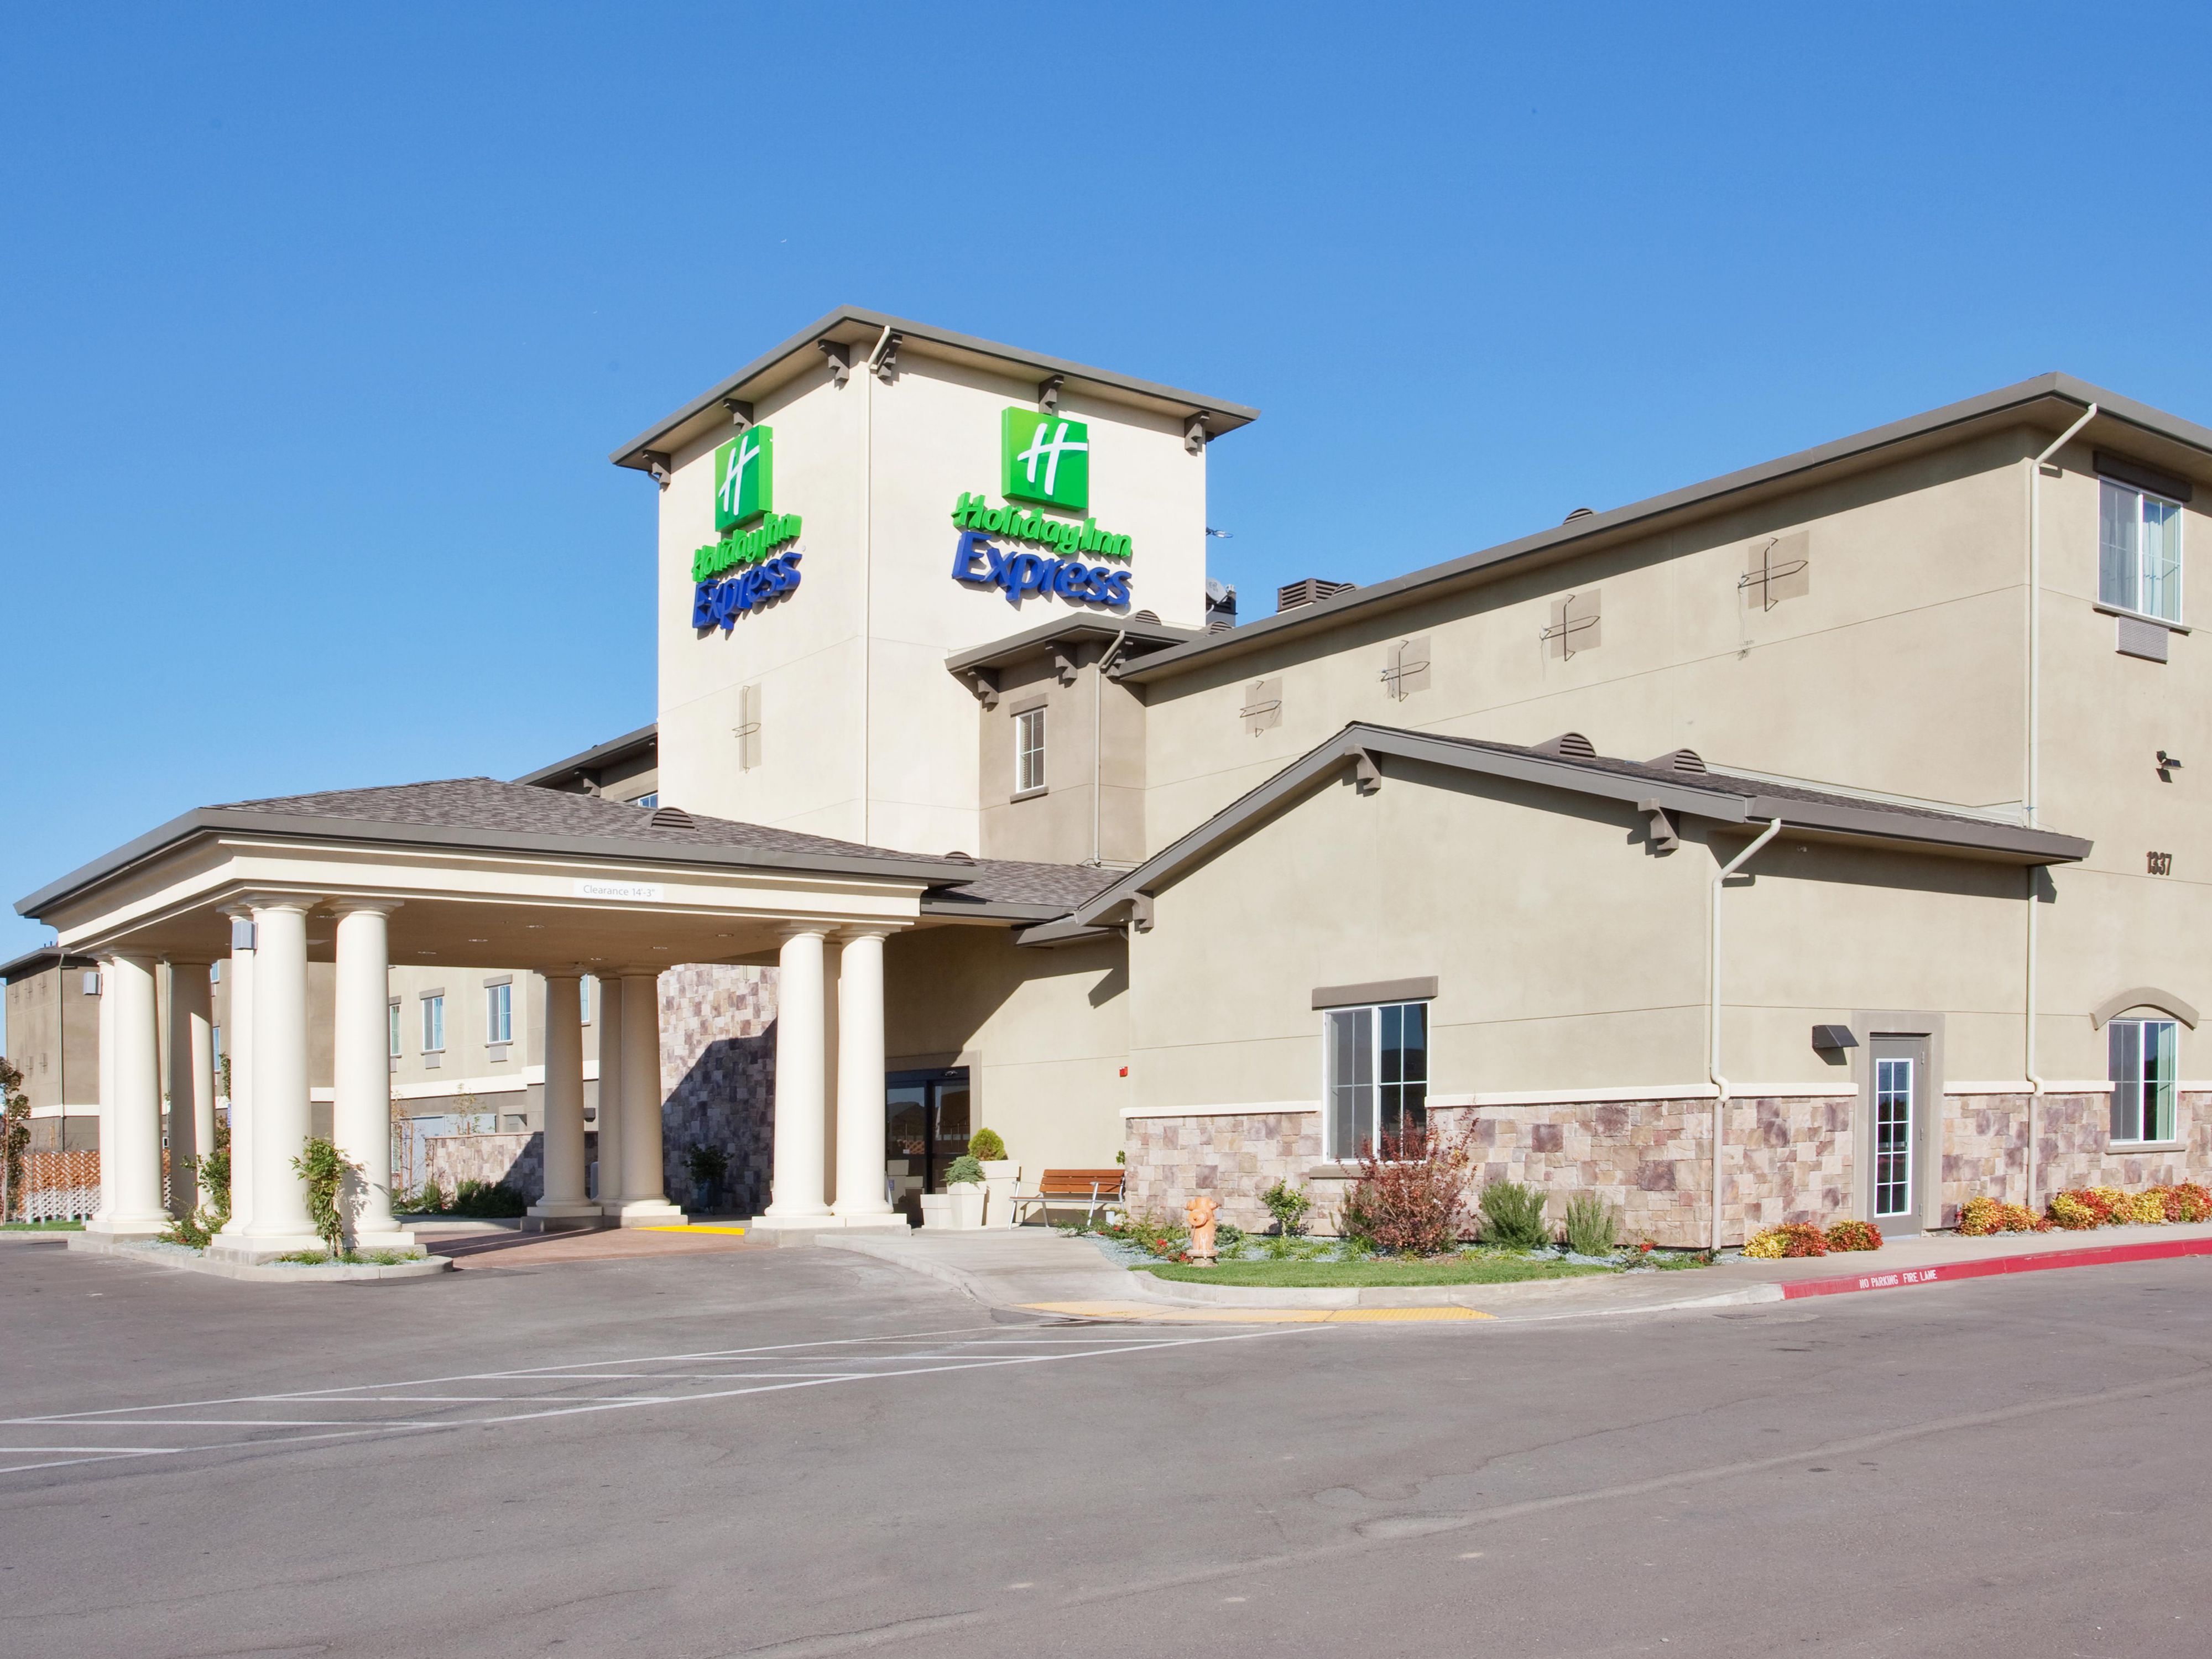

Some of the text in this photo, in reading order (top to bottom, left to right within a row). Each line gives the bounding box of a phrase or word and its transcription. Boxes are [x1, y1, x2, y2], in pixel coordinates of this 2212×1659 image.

[691, 513, 802, 582] Holiday Inn
[951, 492, 1132, 557] Holiday Inn
[692, 552, 802, 629] Express
[952, 531, 1133, 606] Express
[583, 885, 655, 897] Clearance 14'-3"
[2146, 851, 2172, 875] 1337
[1859, 1270, 1937, 1289] NO PARKING FIRE LANE
